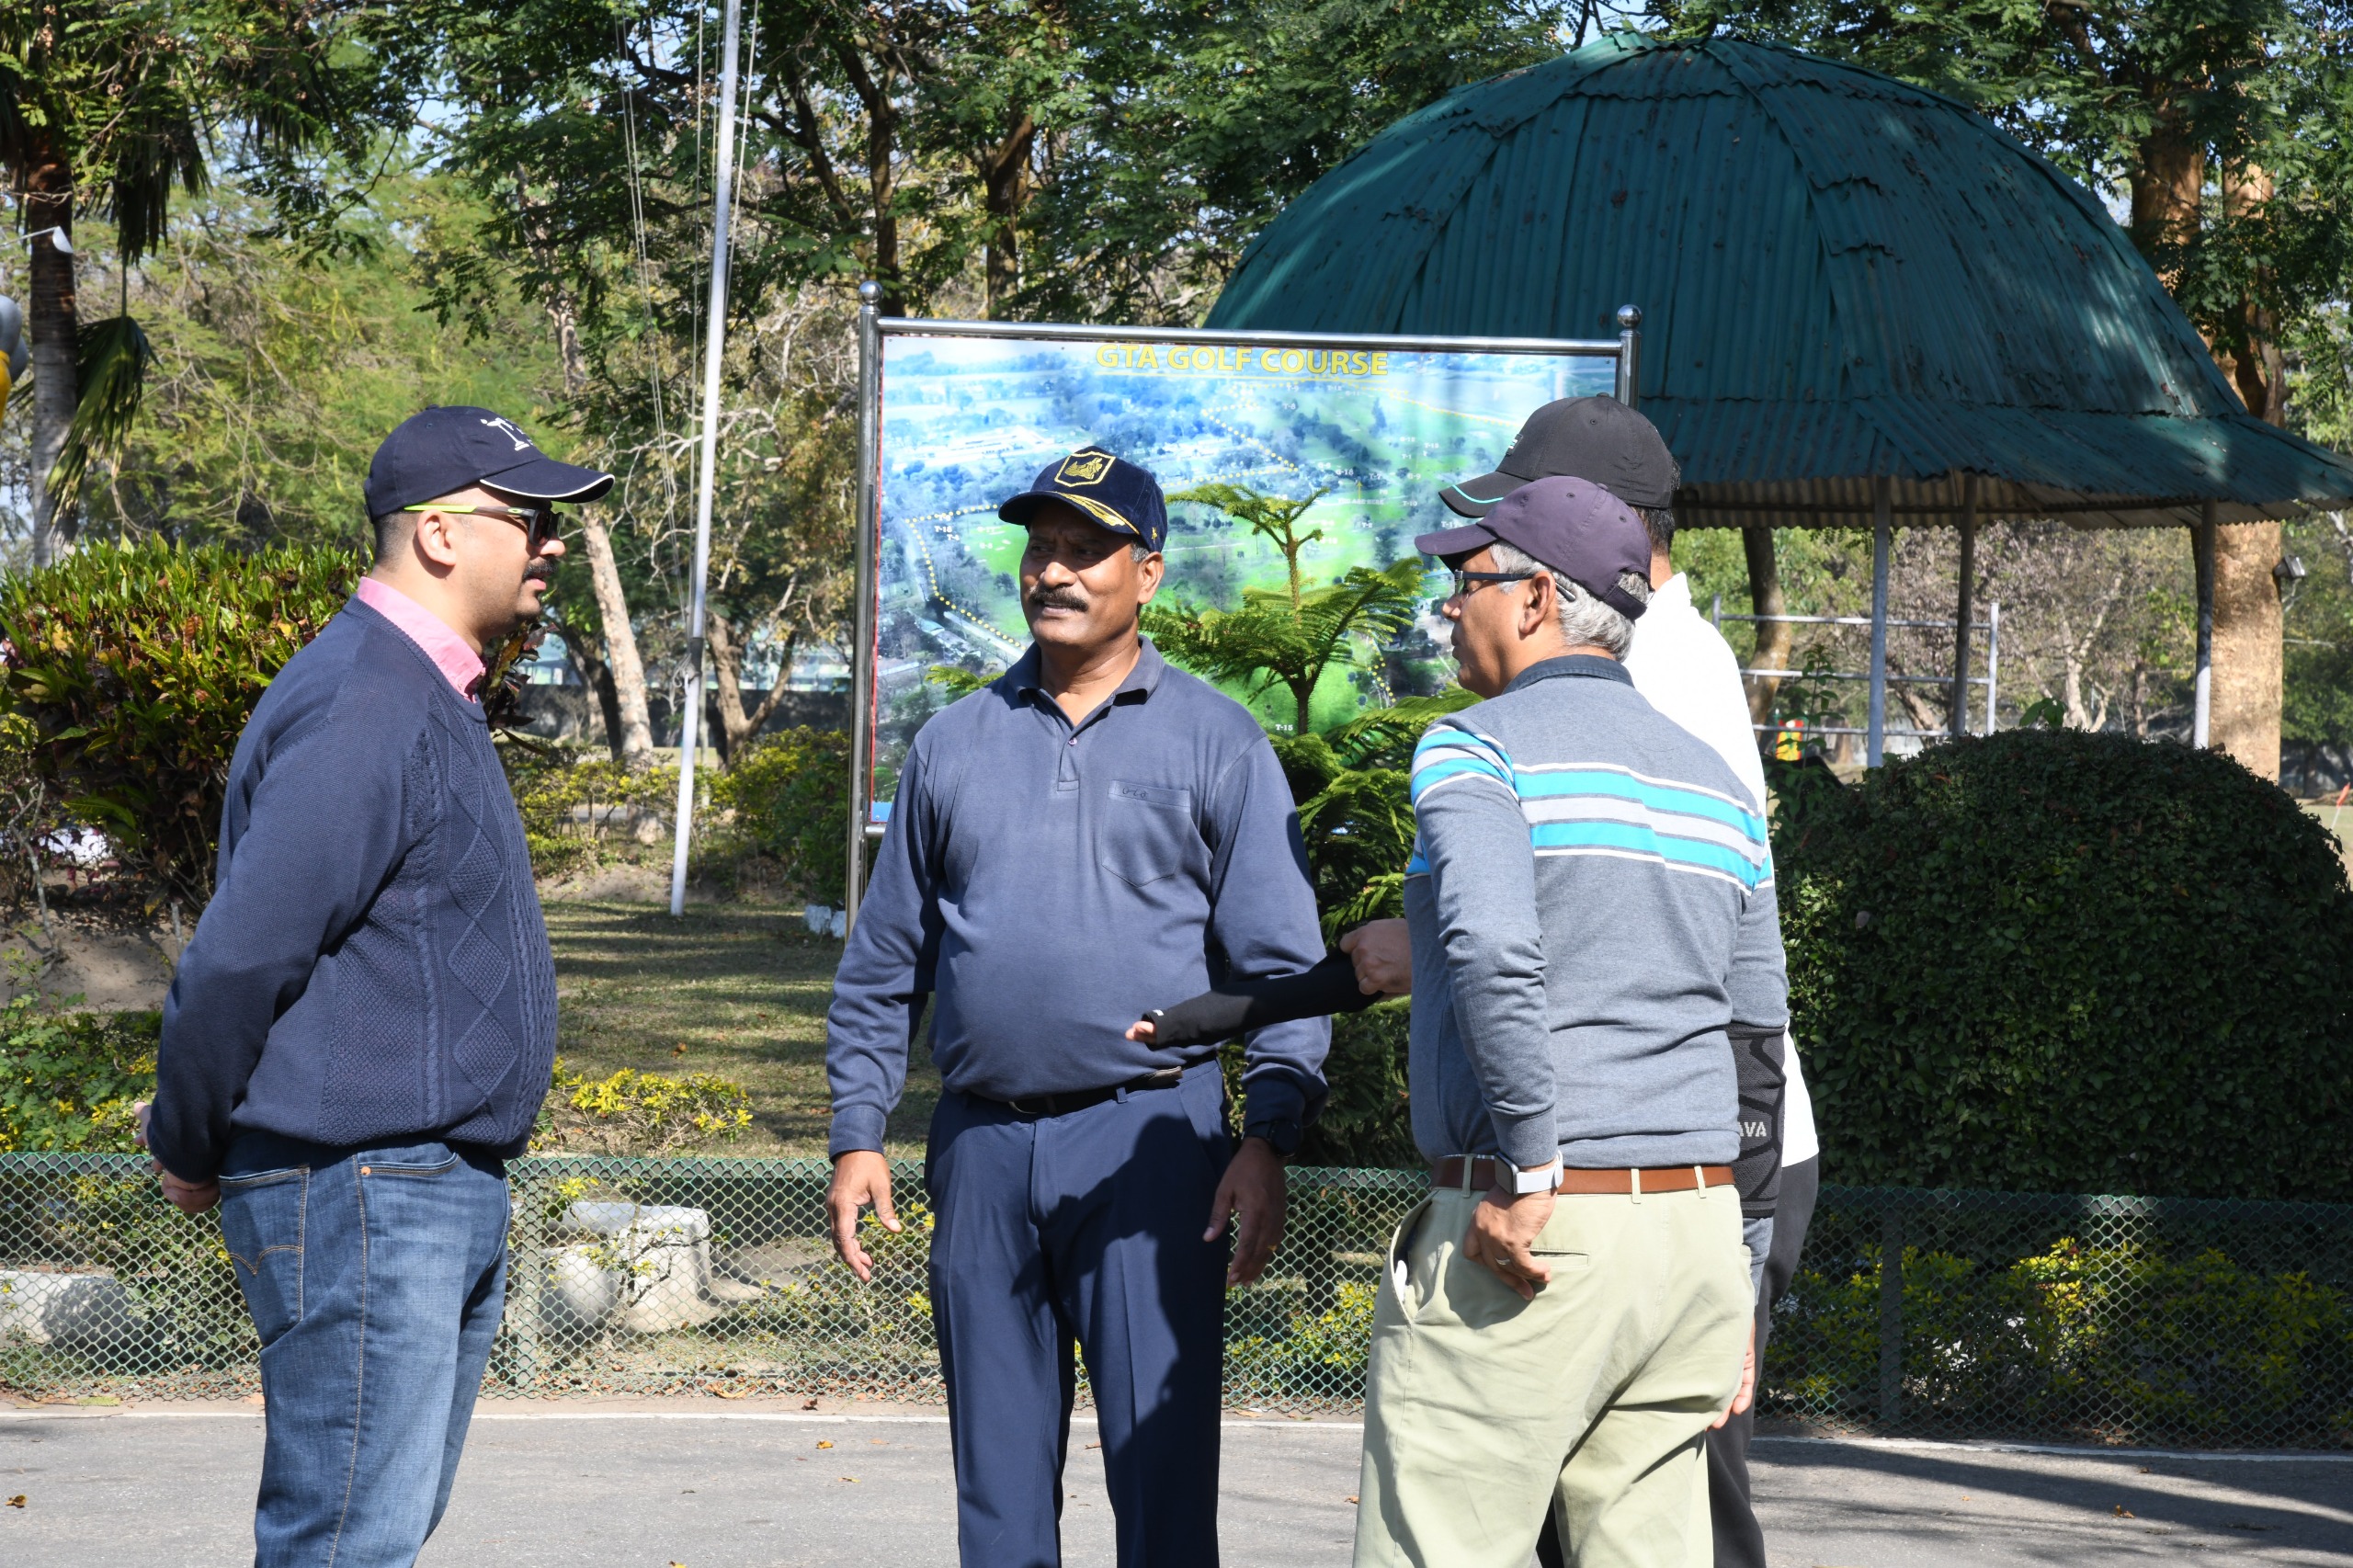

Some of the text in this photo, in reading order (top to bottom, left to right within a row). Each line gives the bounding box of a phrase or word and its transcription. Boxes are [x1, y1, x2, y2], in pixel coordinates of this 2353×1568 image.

[1096, 345, 1388, 376] GTA GOLF COURSE
